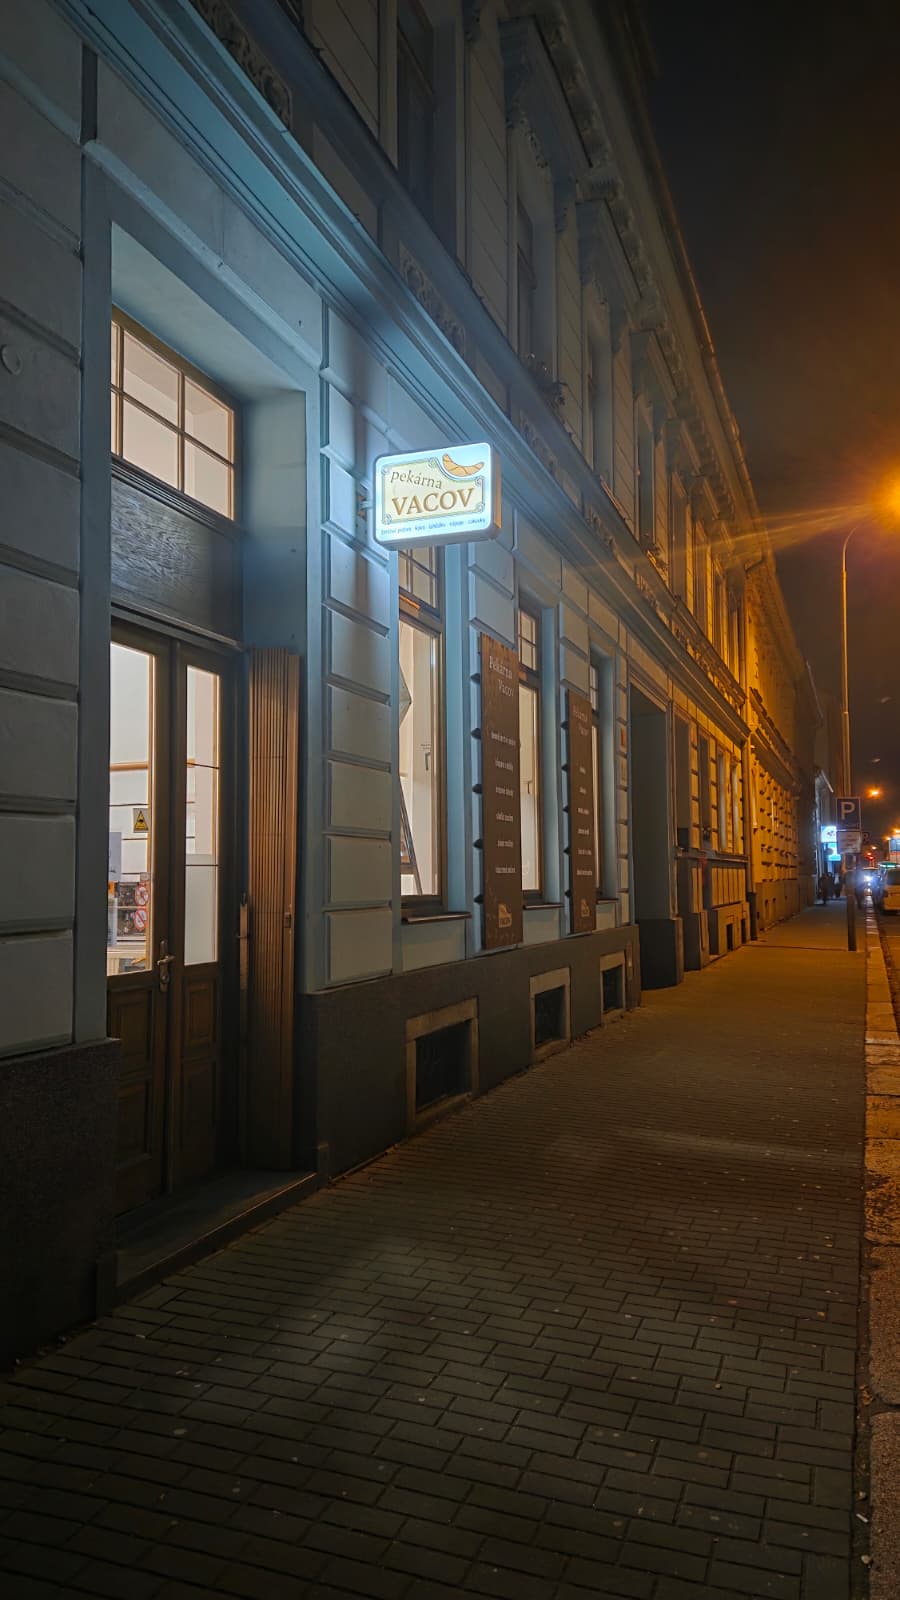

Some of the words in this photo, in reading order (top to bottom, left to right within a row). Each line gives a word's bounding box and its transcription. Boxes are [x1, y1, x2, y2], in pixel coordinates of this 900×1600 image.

[391, 470, 442, 490] pekárna
[392, 488, 474, 515] VACOV
[841, 802, 855, 820] P
